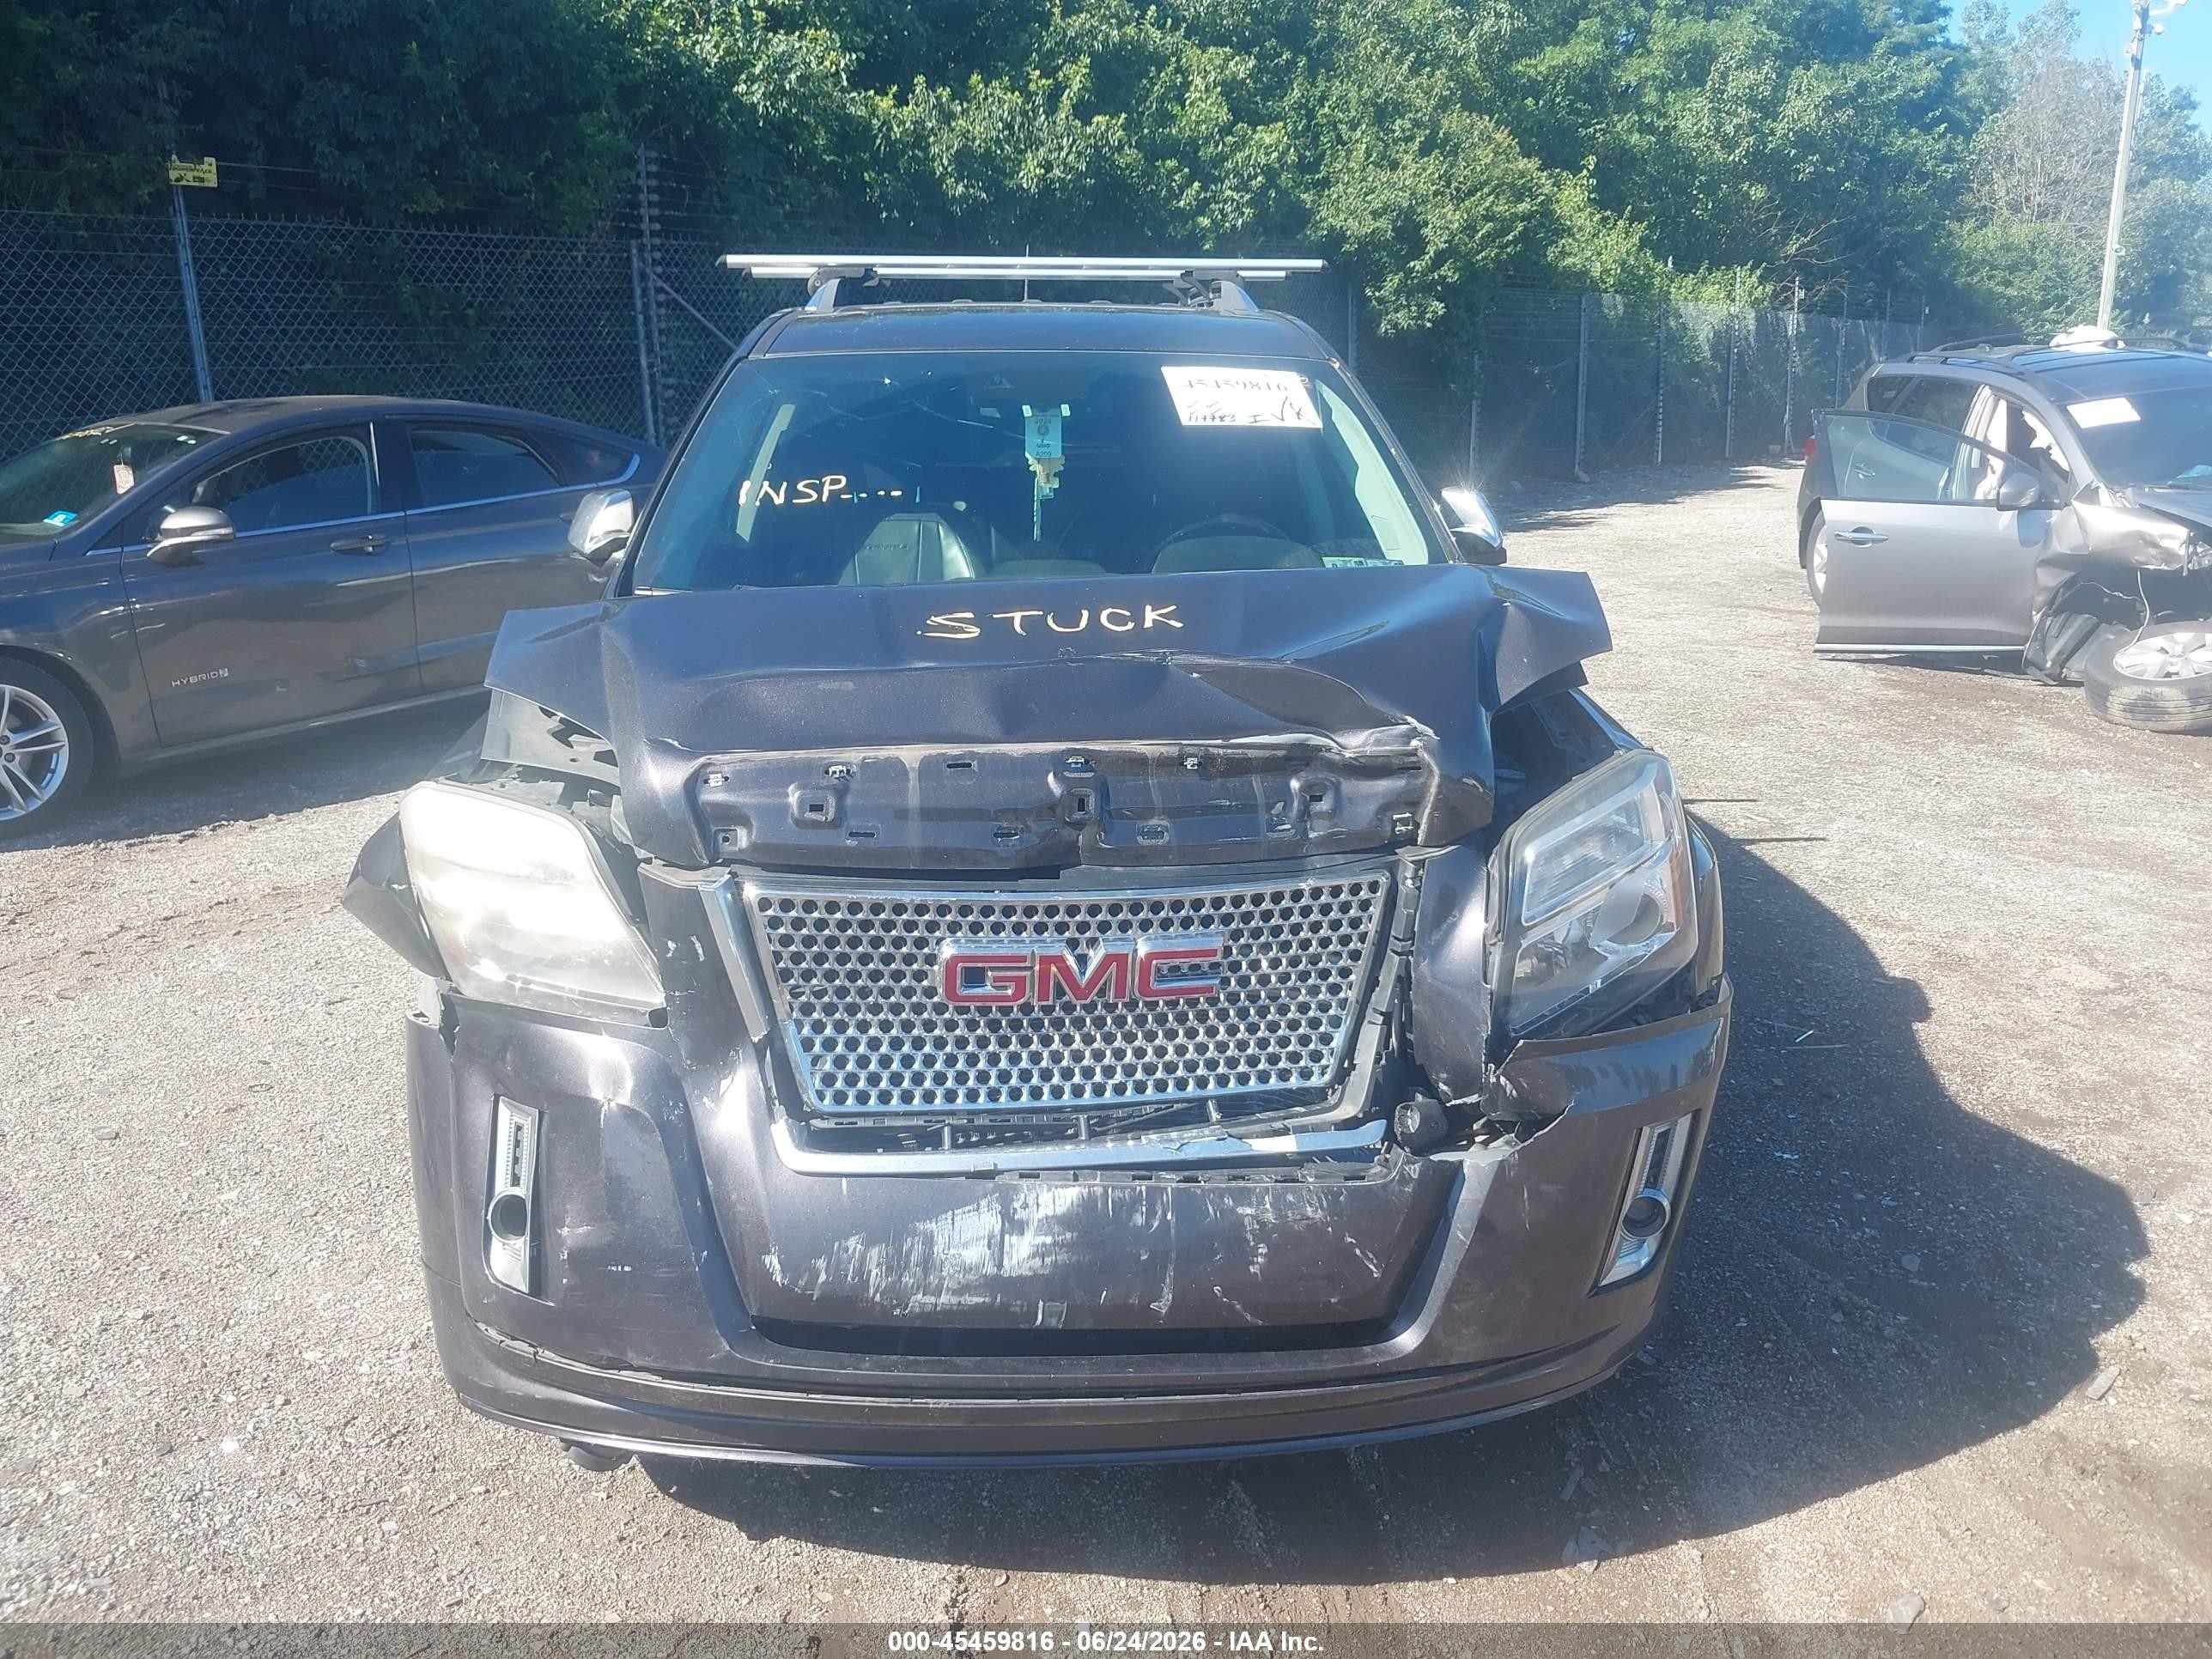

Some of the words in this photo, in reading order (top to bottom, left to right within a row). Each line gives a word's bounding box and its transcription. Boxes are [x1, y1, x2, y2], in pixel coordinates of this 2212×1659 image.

[914, 605, 1183, 638] STUCK
[171, 671, 218, 688] HYBRID
[939, 938, 1223, 1006] GMC
